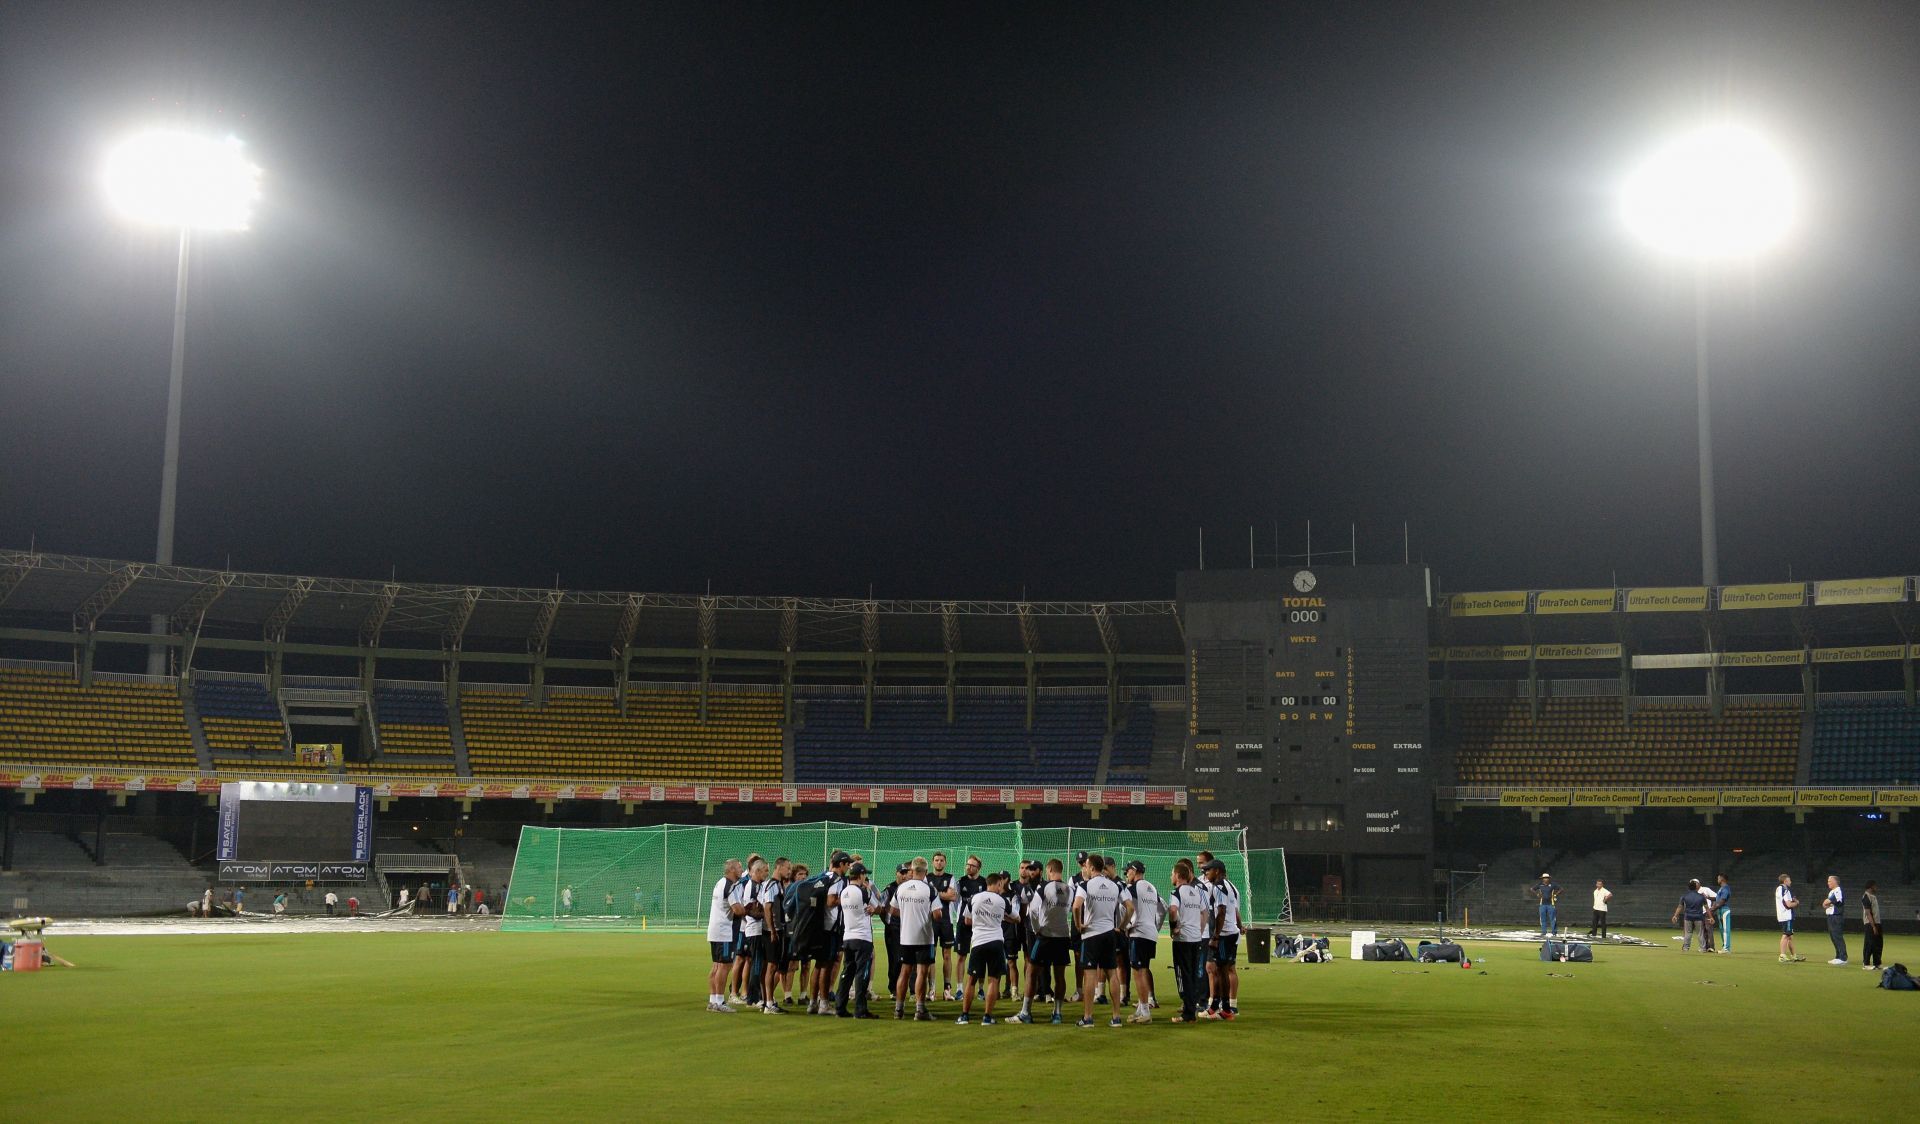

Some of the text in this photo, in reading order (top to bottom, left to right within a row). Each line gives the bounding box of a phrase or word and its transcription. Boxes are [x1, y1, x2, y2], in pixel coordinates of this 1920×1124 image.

[1629, 595, 1705, 605] UltraTech Cement
[1723, 591, 1801, 602] UltraTech Cement
[1282, 597, 1326, 608] TOTAL
[1453, 599, 1524, 609] UltraTech Cement
[1539, 598, 1612, 608] UltraTech Cement
[1290, 611, 1319, 623] 000
[1290, 635, 1317, 643] WKTS
[1449, 648, 1527, 659] UltraTech Cement
[1539, 647, 1582, 657] UltraTech
[1815, 650, 1862, 660] UltraTech
[1863, 648, 1901, 659] Cement
[1719, 654, 1763, 665] UltraTech
[1764, 652, 1801, 664] Cement
[1281, 696, 1296, 706] 00
[1322, 696, 1337, 706] 00
[1280, 712, 1334, 720] B O R W
[1503, 794, 1567, 803] UltraTech Cement
[1575, 794, 1640, 803] UltraTech Cement
[1649, 795, 1716, 803] UltraTech Cement
[1723, 795, 1791, 803] UltraTech Cement
[1800, 793, 1870, 802] UltraTech Cement
[1879, 793, 1918, 802] UltraTech
[222, 865, 268, 873] ATOM
[321, 866, 365, 874] ATOM
[900, 896, 925, 905] Waitrose
[975, 910, 1002, 919] Waitrose
